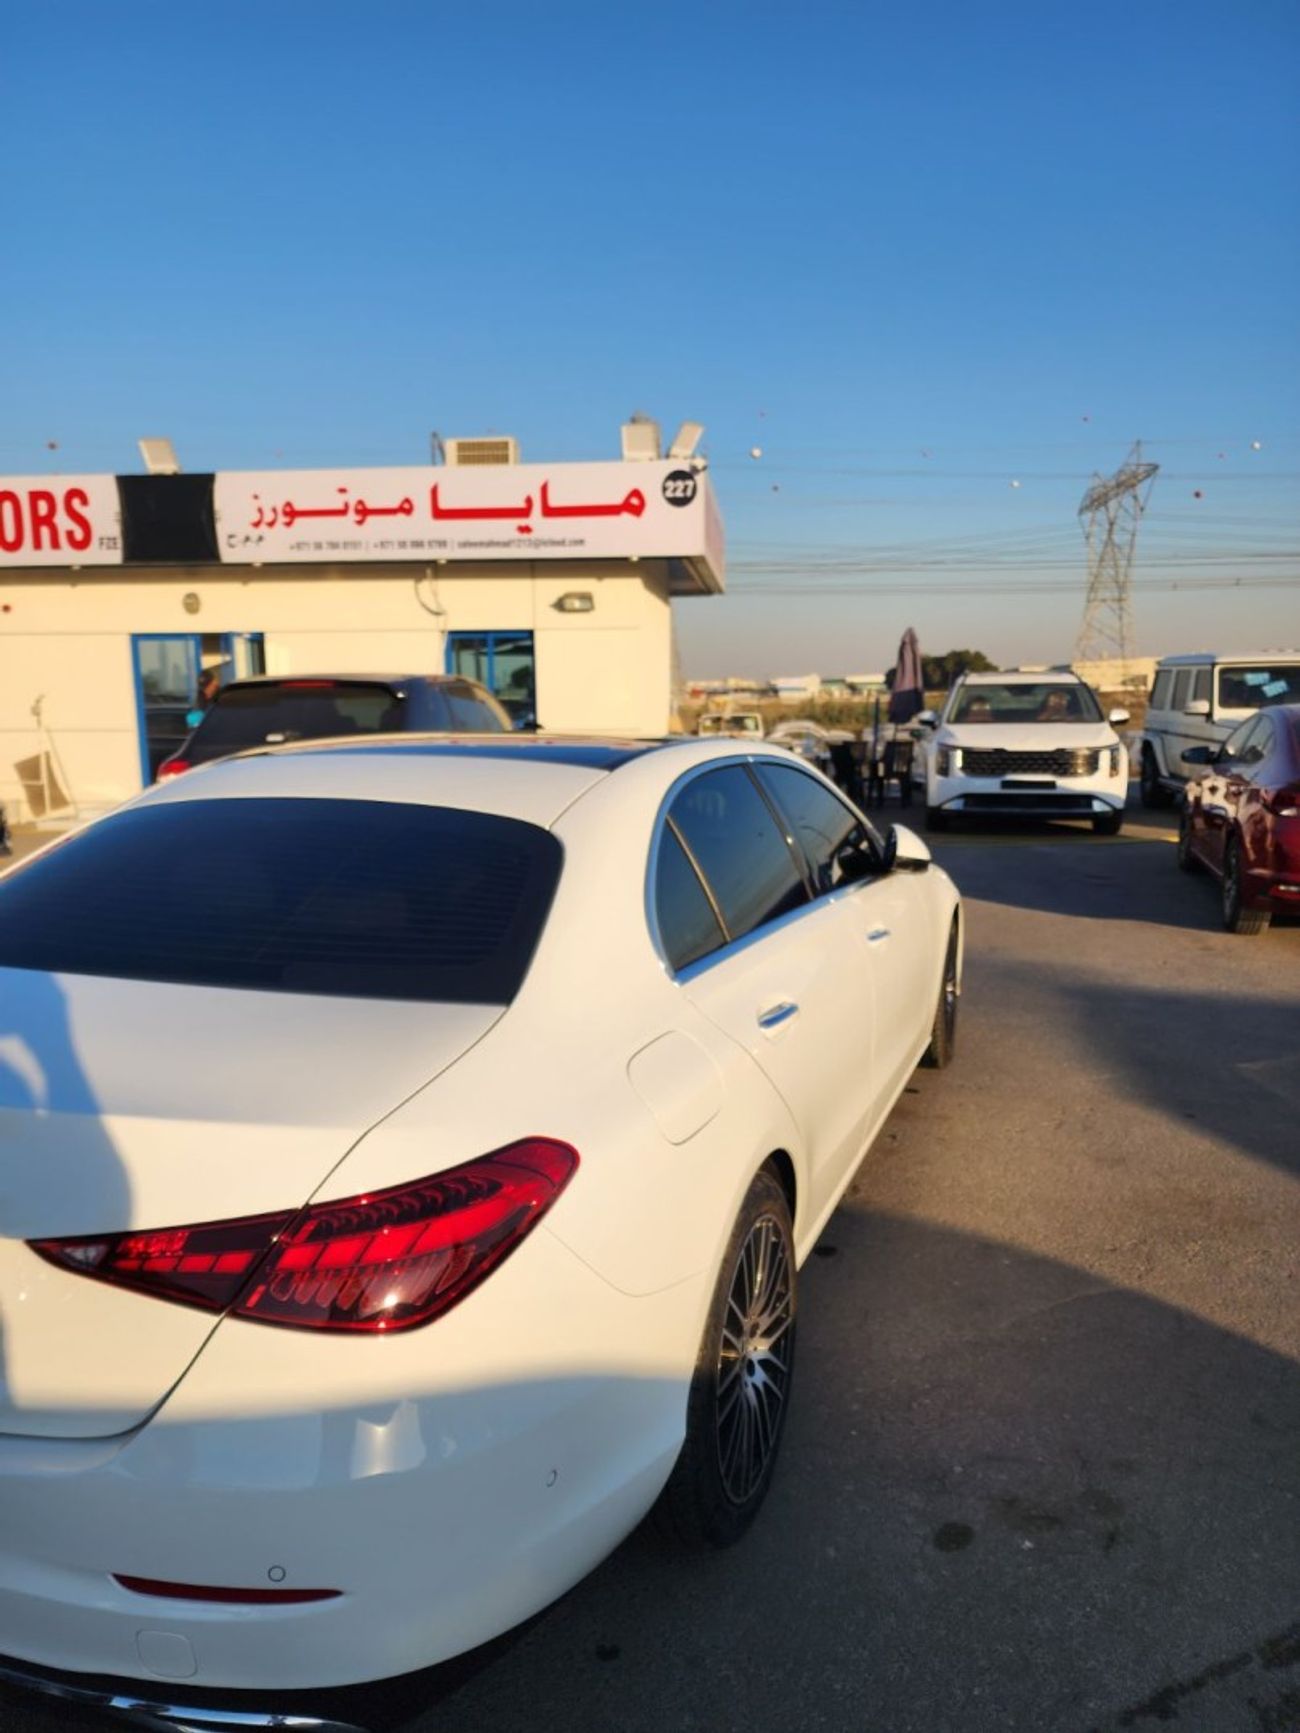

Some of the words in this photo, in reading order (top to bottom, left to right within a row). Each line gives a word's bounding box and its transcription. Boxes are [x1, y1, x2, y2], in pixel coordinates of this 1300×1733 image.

[250, 486, 414, 528] موتورز
[430, 480, 646, 534] مايا
[664, 479, 695, 499] 227
